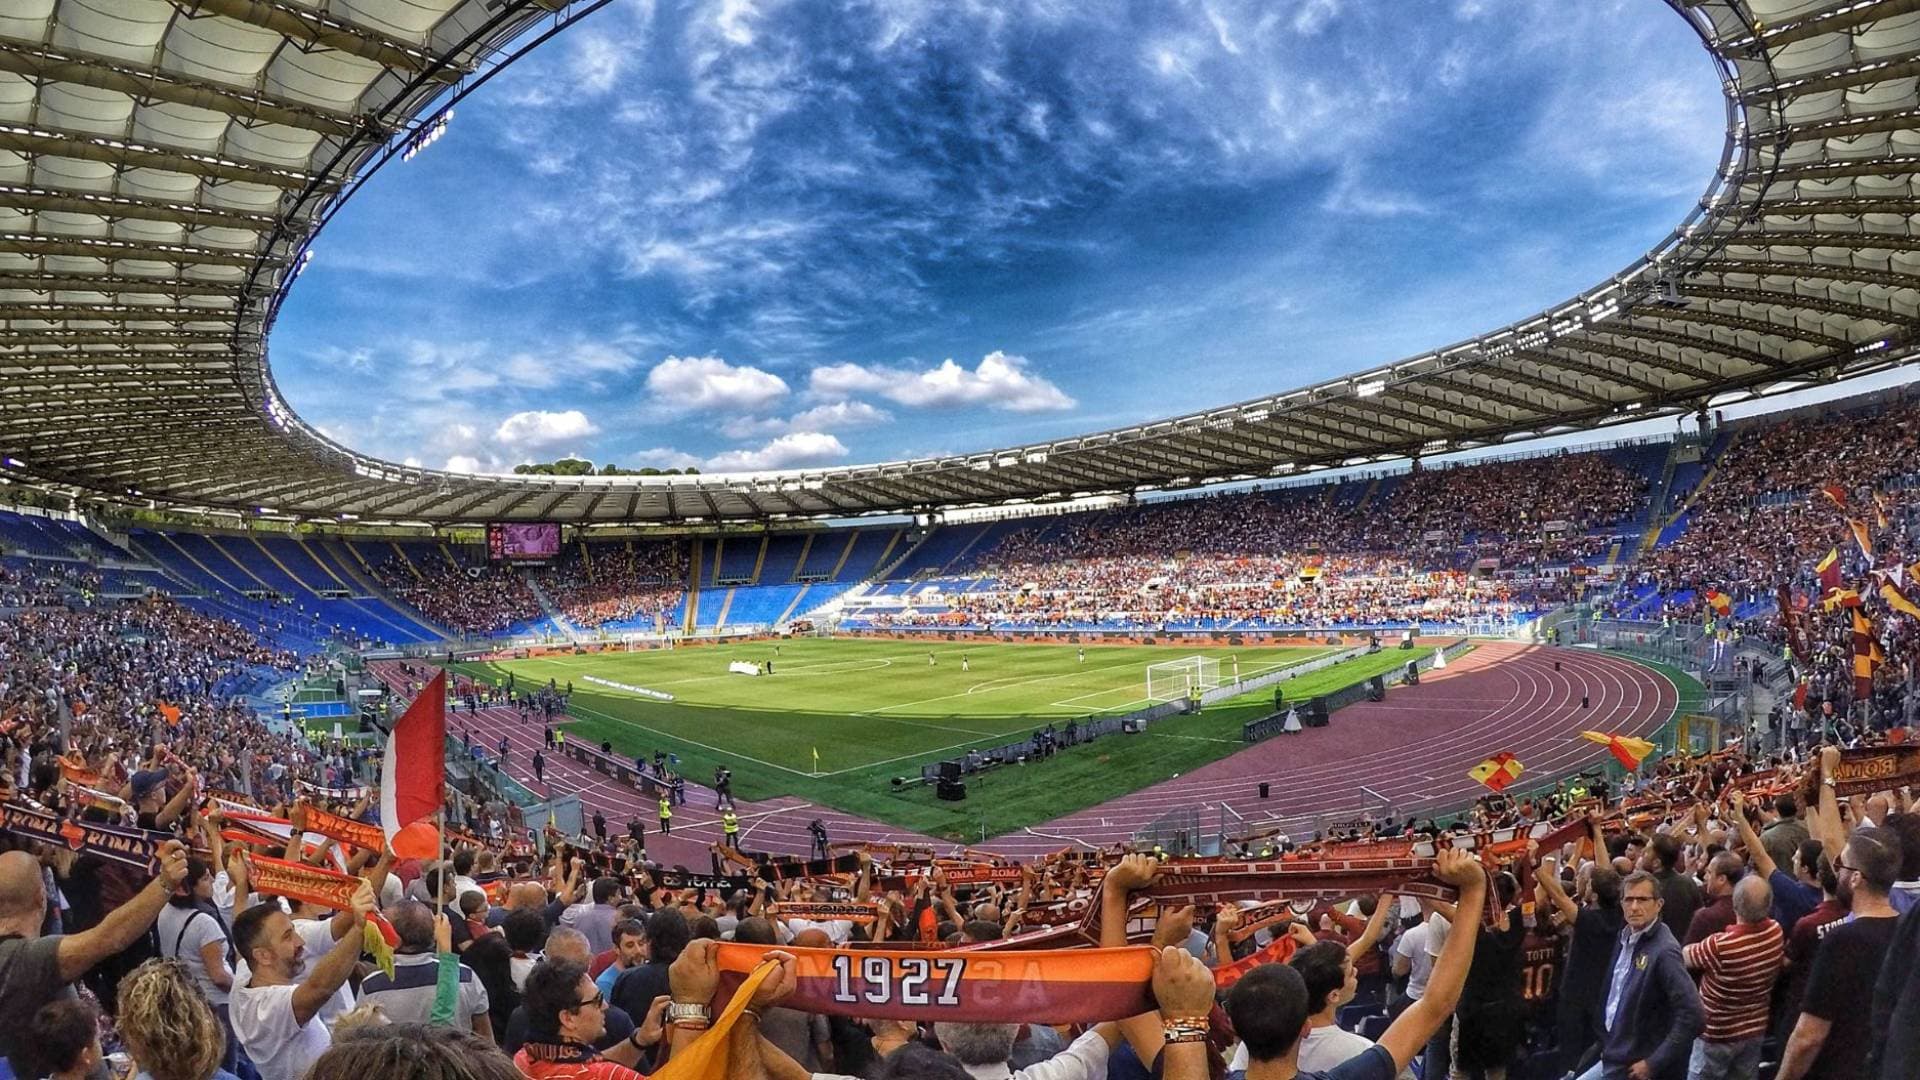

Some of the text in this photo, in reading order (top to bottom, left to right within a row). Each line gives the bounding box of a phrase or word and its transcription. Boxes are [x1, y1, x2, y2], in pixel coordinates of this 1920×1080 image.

[87, 831, 143, 855] ROMA
[991, 868, 1022, 880] ROMA
[832, 954, 967, 1005] 1927
[1523, 963, 1553, 999] 10
